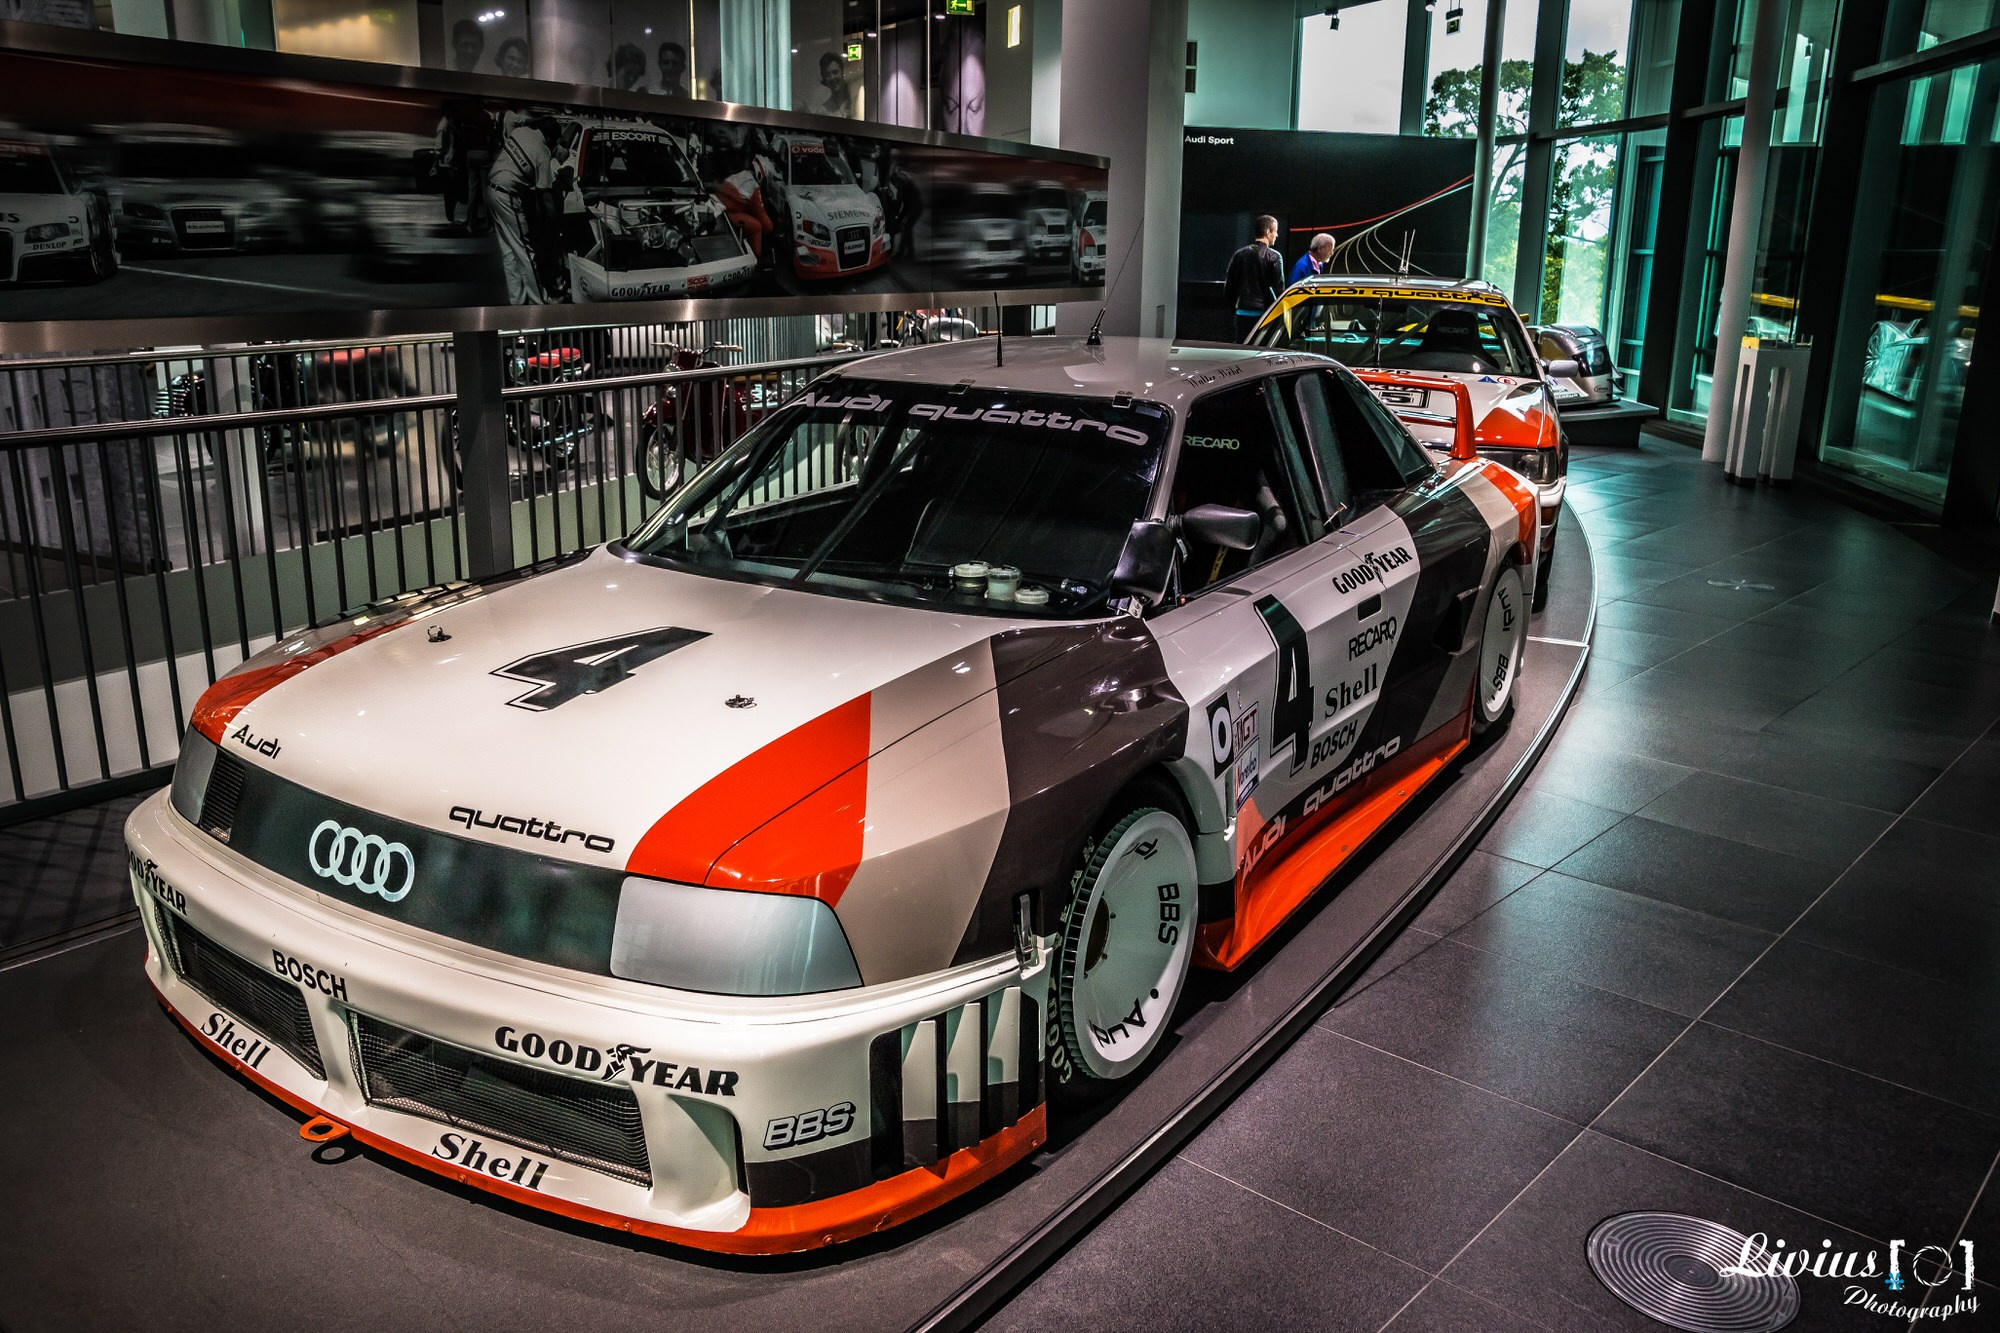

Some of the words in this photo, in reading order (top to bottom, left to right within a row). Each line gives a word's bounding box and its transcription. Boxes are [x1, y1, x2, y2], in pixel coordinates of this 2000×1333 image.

[611, 131, 657, 143] ESCORT
[1184, 134, 1206, 145] Audi
[1208, 135, 1235, 147] Sport
[32, 241, 67, 251] DUNLOP
[1286, 287, 1364, 297] Audi
[1371, 289, 1506, 304] quattro
[797, 392, 892, 413] Audi
[907, 403, 1149, 447] quattro
[1184, 434, 1241, 452] RECARO
[1348, 616, 1398, 661] RECARO
[488, 625, 714, 713] 4
[1252, 594, 1314, 777] 4
[1324, 664, 1378, 719] Shell
[1492, 653, 1509, 691] BBS
[231, 723, 282, 760] Audi
[1310, 720, 1358, 769] BOSCH
[449, 804, 616, 854] quattro
[1241, 815, 1286, 891] Audi
[1302, 736, 1401, 817] quattro
[1157, 882, 1181, 946] BBS
[272, 948, 349, 1002] BOSCH
[200, 1011, 271, 1071] Shell
[763, 1101, 856, 1151] BBS
[432, 1132, 549, 1191] Shell
